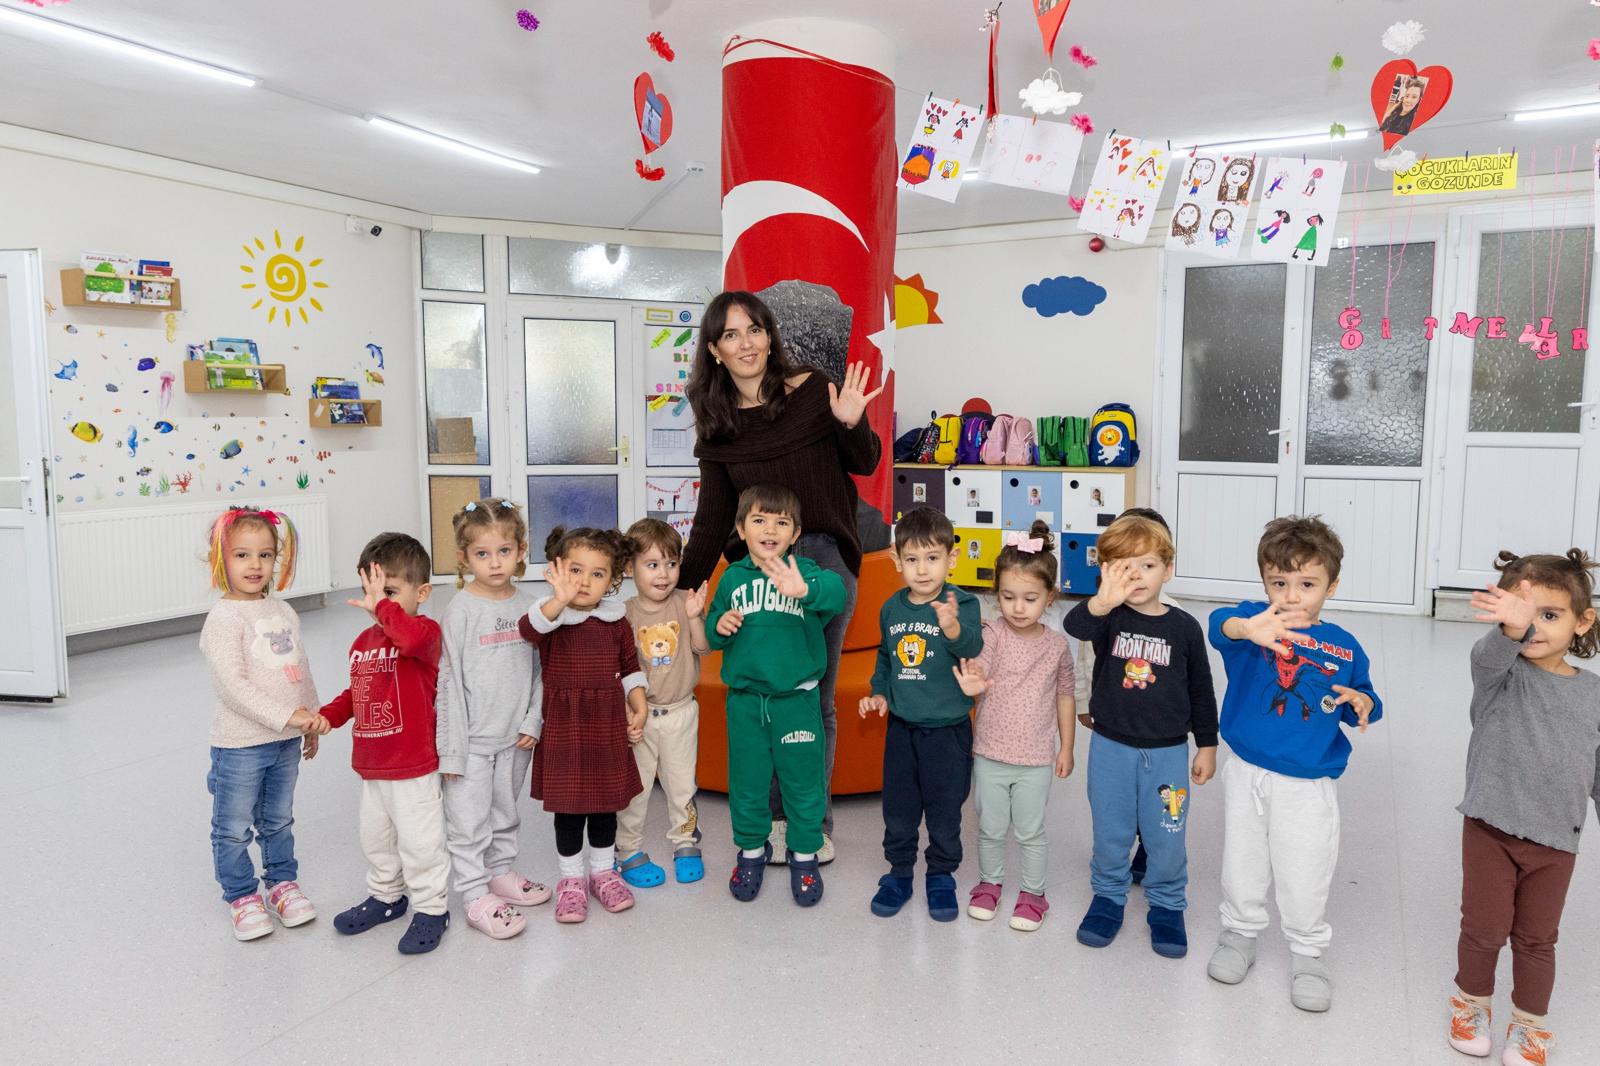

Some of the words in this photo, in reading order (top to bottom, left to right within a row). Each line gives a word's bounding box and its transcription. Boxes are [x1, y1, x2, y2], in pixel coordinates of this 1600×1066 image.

[890, 622, 907, 637] ROAR
[914, 621, 941, 637] BRAVE
[1120, 631, 1132, 639] THE
[1132, 633, 1167, 645] INVINCIBLE
[1111, 635, 1144, 659] IRON
[1143, 640, 1172, 667] MAN
